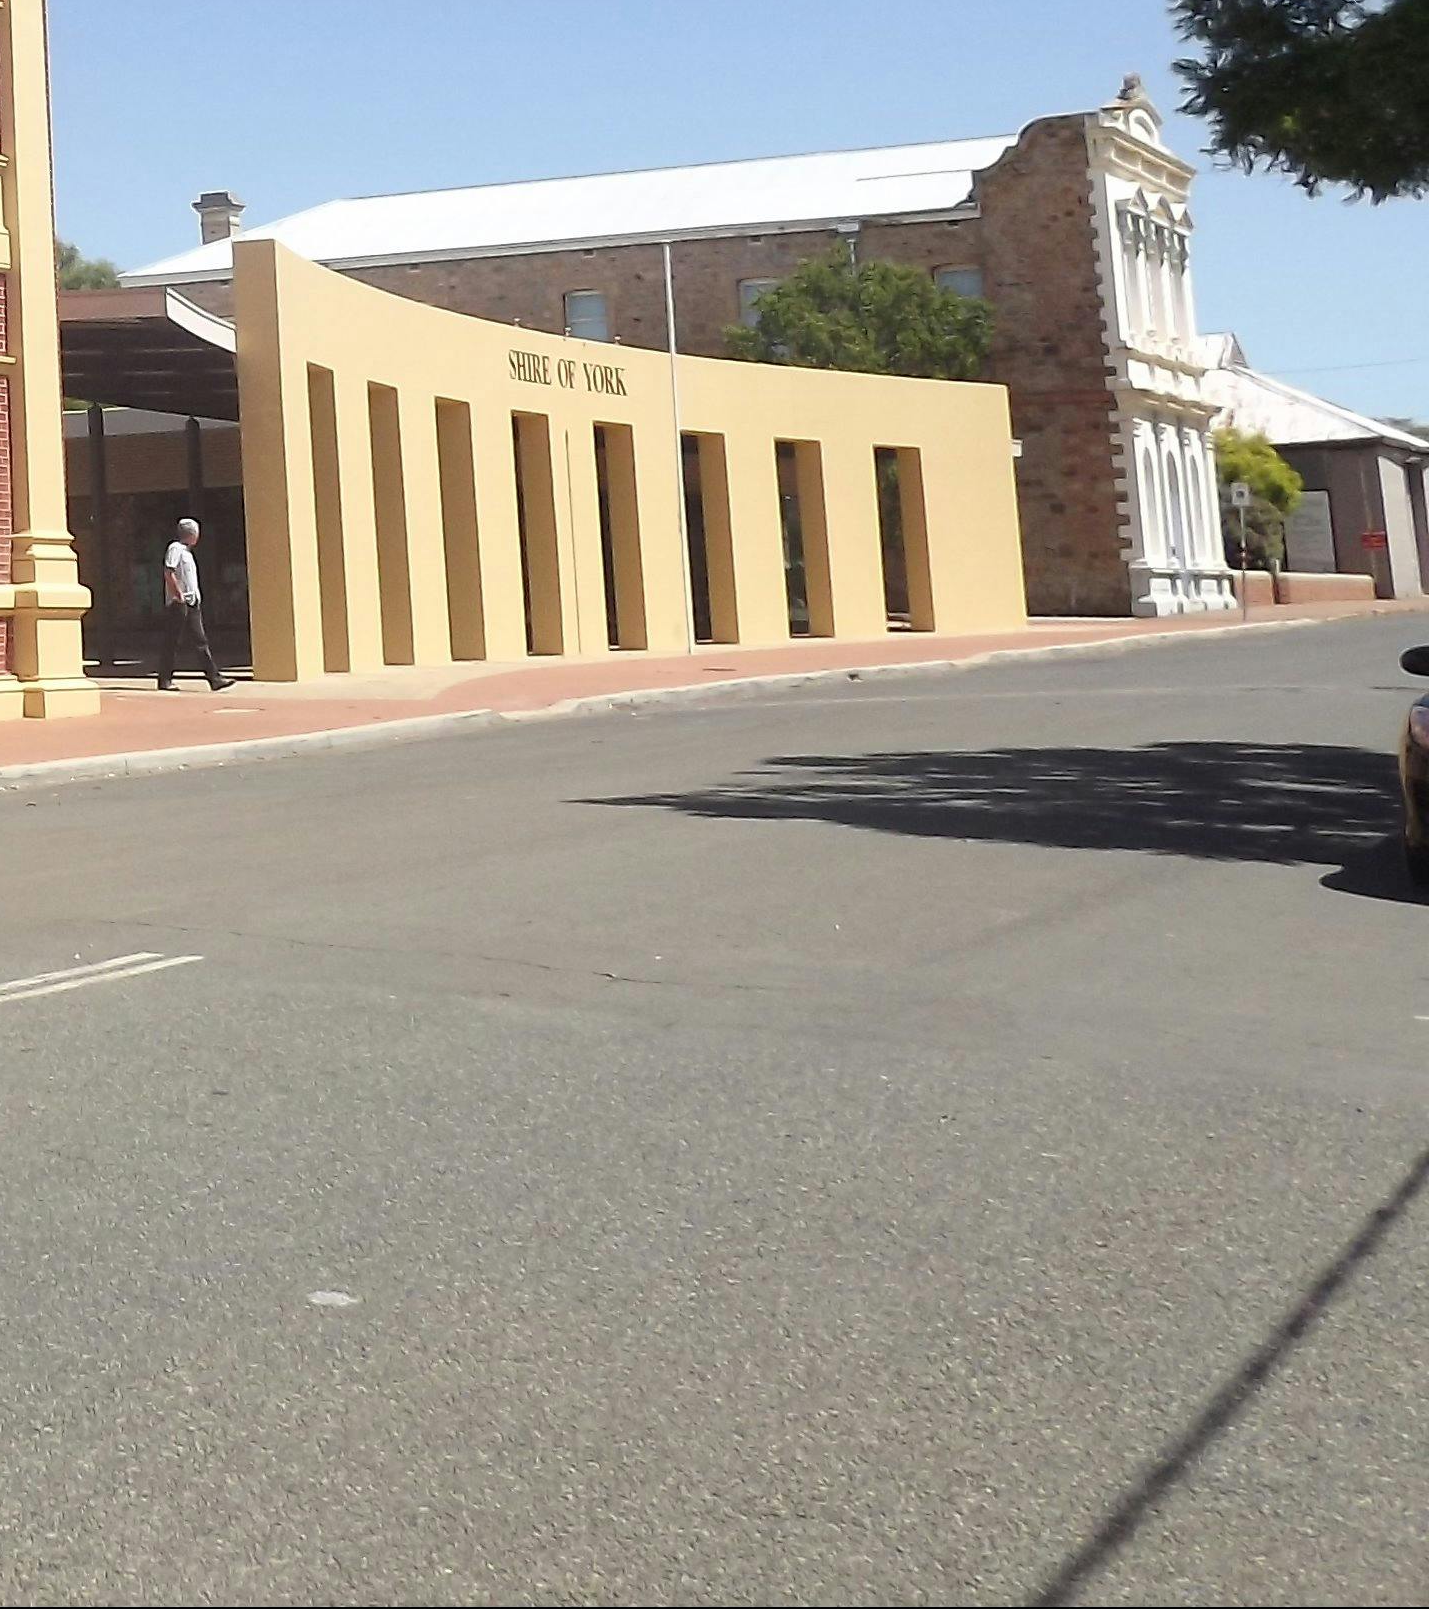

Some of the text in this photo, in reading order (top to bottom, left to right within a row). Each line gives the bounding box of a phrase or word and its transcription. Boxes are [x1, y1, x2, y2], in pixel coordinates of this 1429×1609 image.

[508, 349, 628, 396] SHIRE OF YORK
